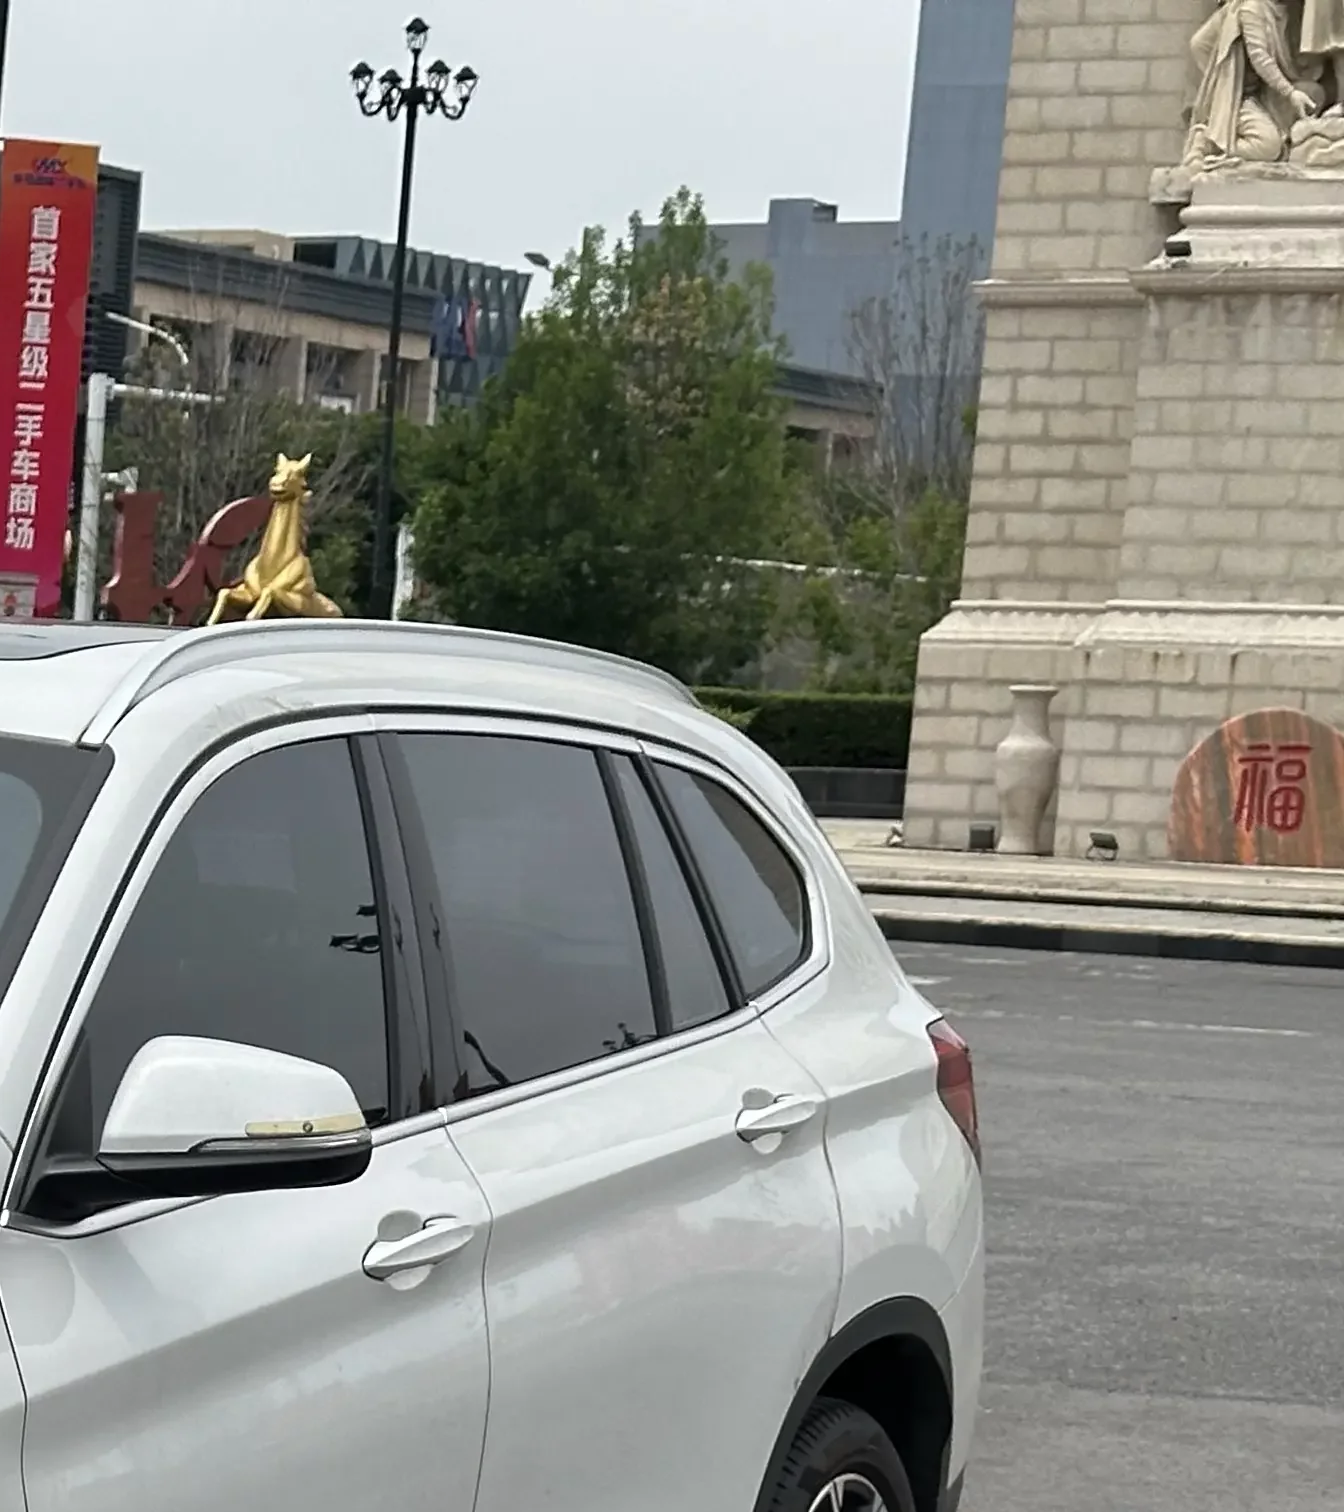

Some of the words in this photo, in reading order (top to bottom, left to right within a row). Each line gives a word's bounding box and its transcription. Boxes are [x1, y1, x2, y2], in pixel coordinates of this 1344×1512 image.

[4, 205, 61, 550] 首家五星级二手车商场
[1234, 743, 1314, 834] 福
